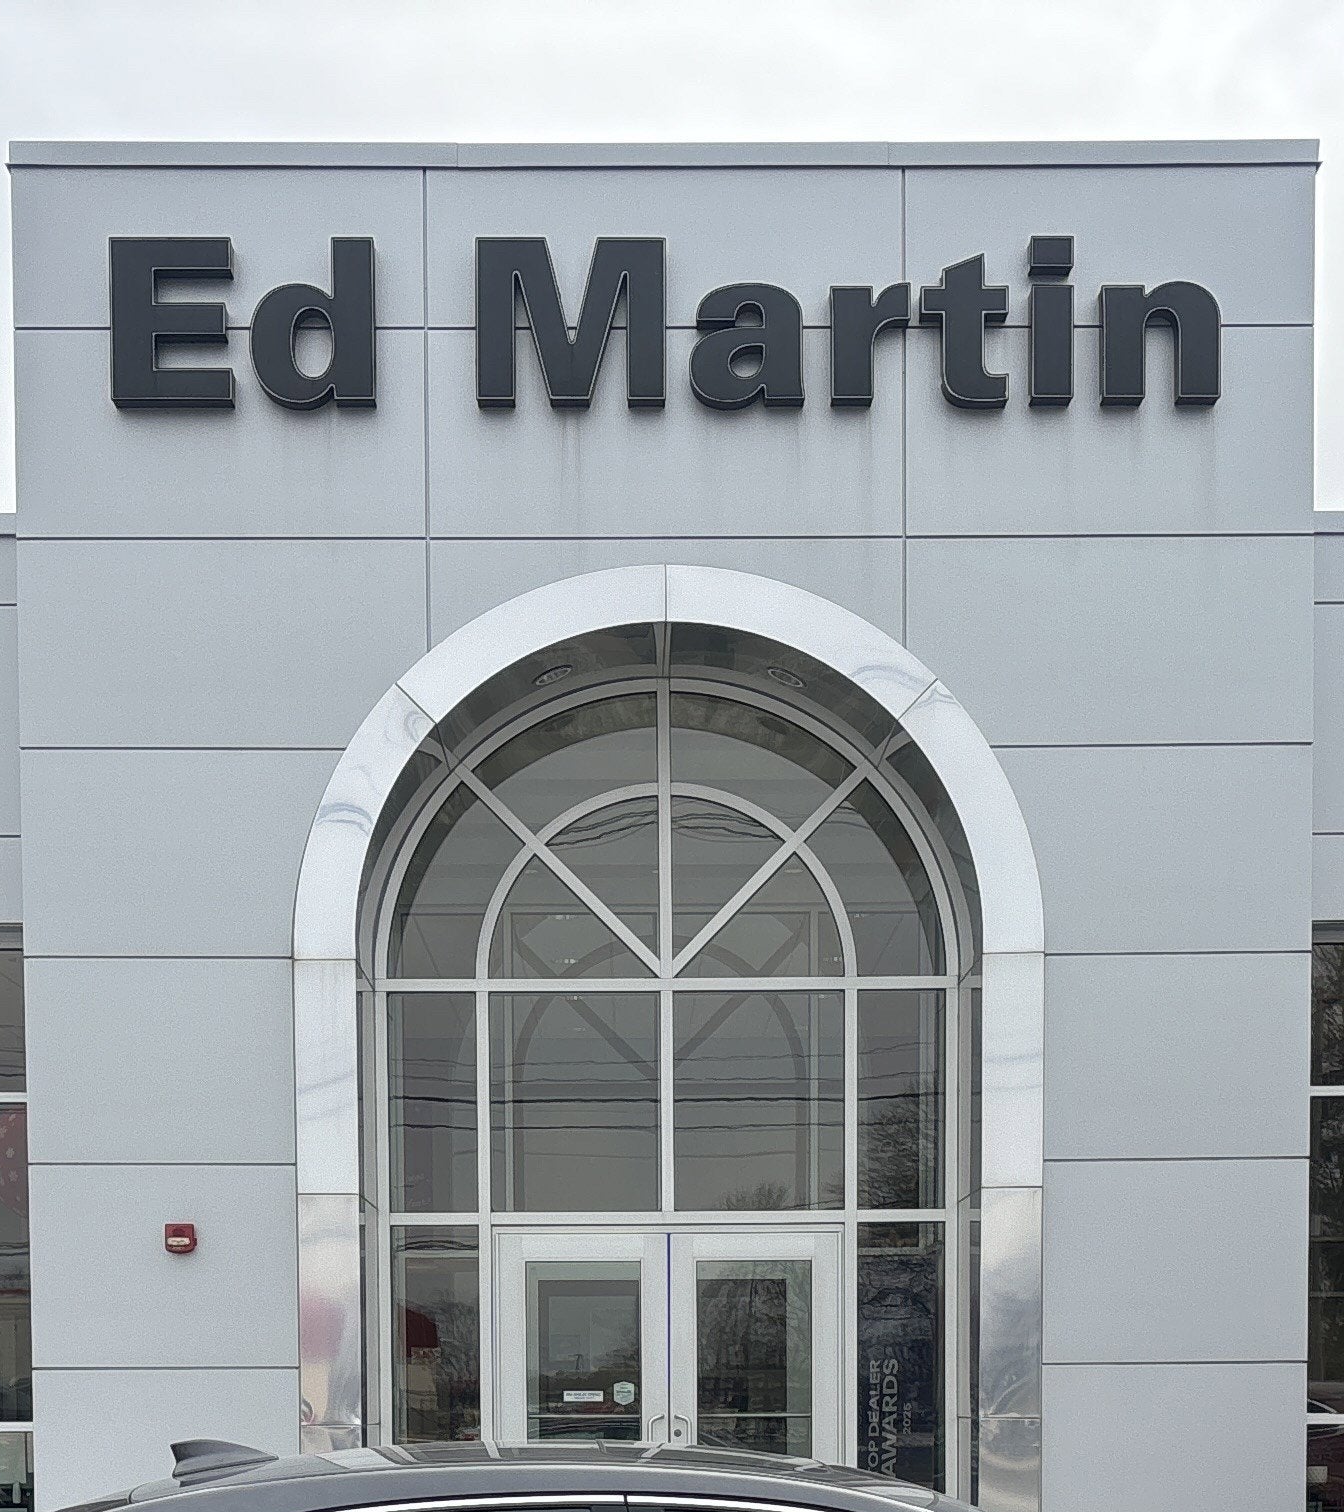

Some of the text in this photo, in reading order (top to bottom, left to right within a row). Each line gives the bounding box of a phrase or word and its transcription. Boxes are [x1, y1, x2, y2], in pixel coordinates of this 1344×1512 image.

[109, 235, 1223, 409] Ed Martin
[867, 1360, 881, 1437] DEALER
[881, 1358, 899, 1478] AWARDS
